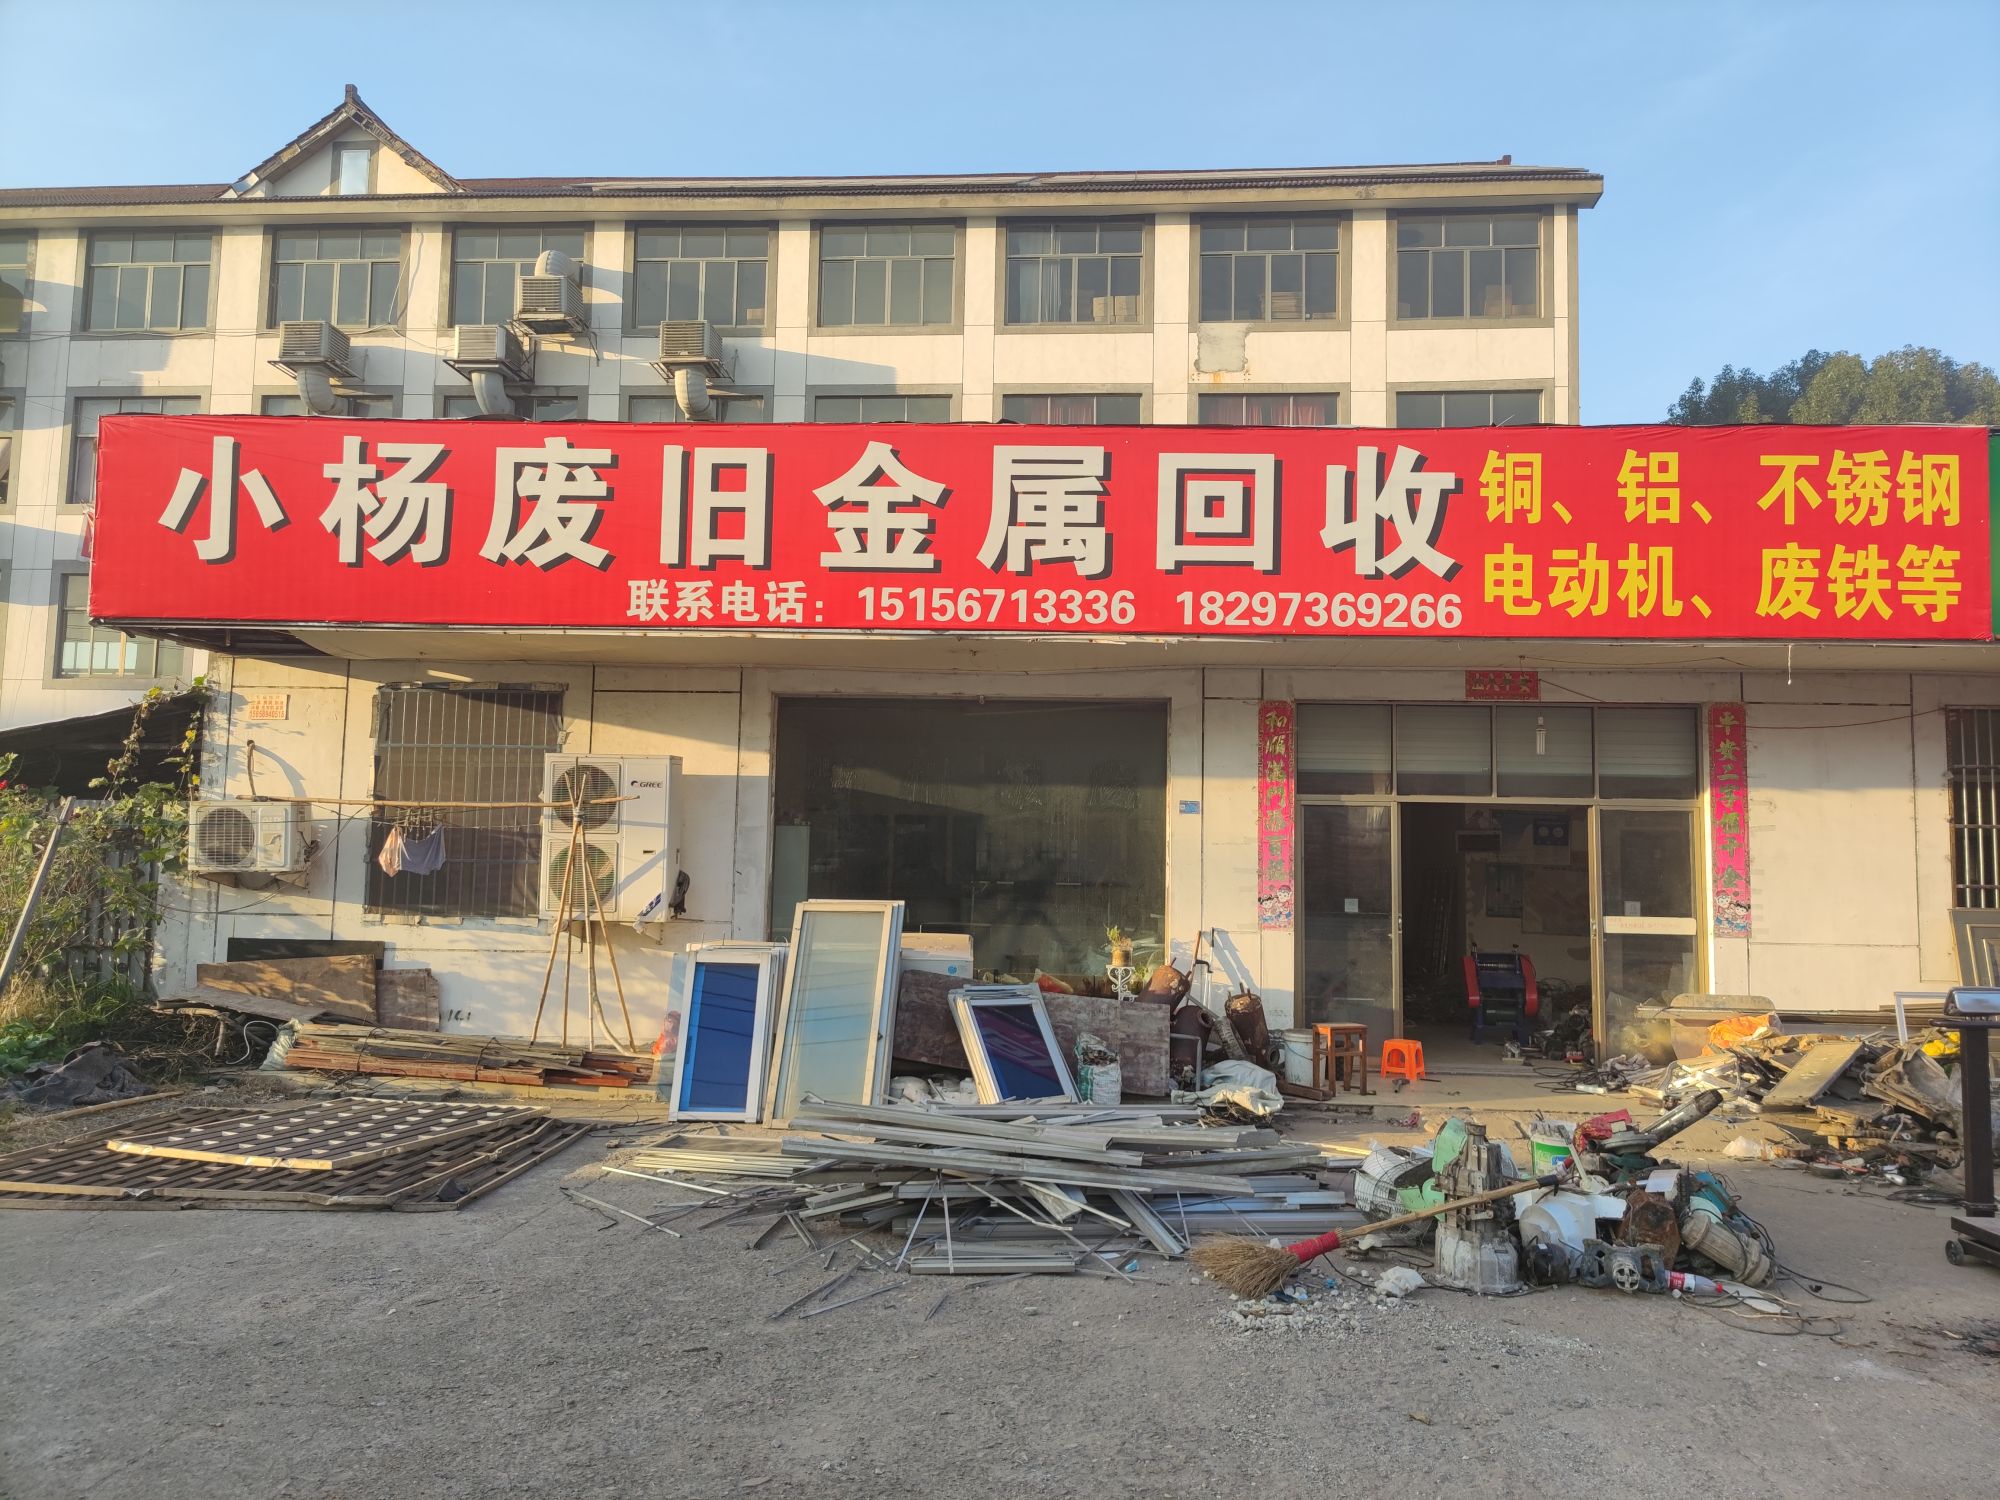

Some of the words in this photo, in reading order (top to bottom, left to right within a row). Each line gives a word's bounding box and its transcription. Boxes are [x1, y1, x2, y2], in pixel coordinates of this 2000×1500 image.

[158, 436, 1460, 578] 小杨废旧金属回收
[857, 586, 1136, 625] 15156713336
[1177, 591, 1463, 631] 18297369266
